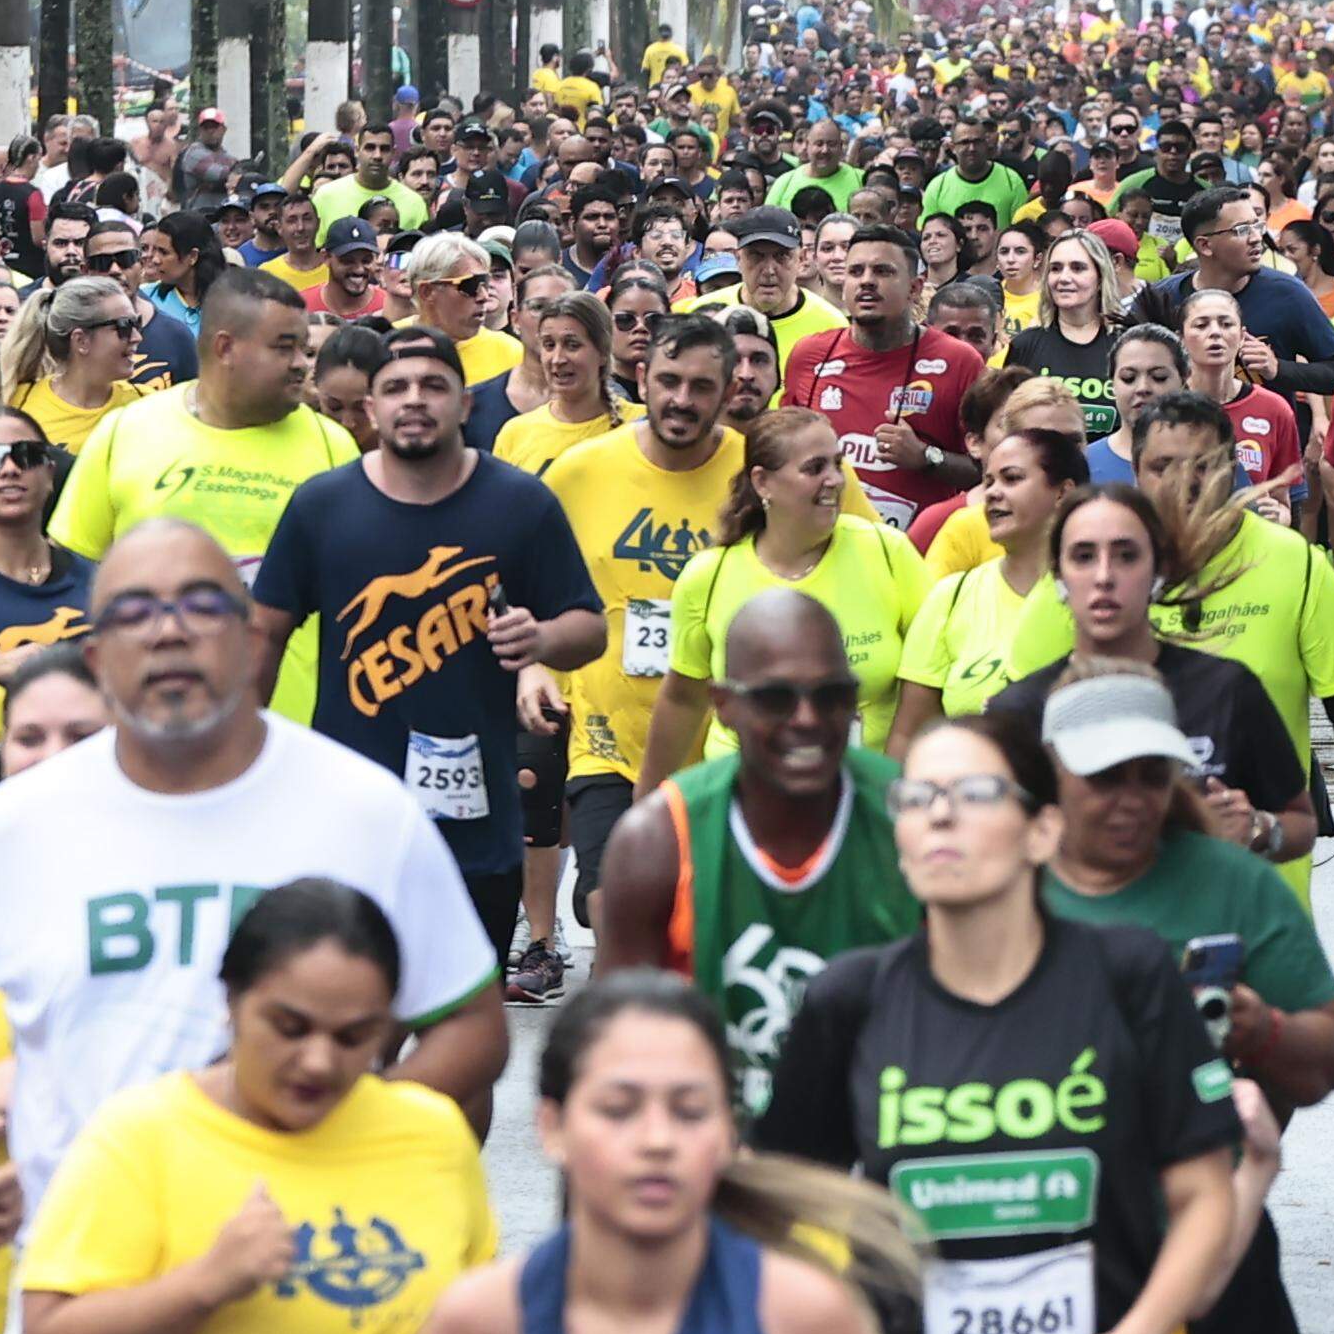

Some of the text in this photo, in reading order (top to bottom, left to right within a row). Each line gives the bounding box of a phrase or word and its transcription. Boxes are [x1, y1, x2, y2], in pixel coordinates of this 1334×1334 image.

[893, 391, 928, 407] KRILL
[1235, 450, 1262, 464] RILL
[1167, 602, 1271, 627] S.agalhães
[418, 765, 479, 790] 2593
[877, 1046, 1107, 1150] issoé
[909, 1170, 1039, 1212] Unimed
